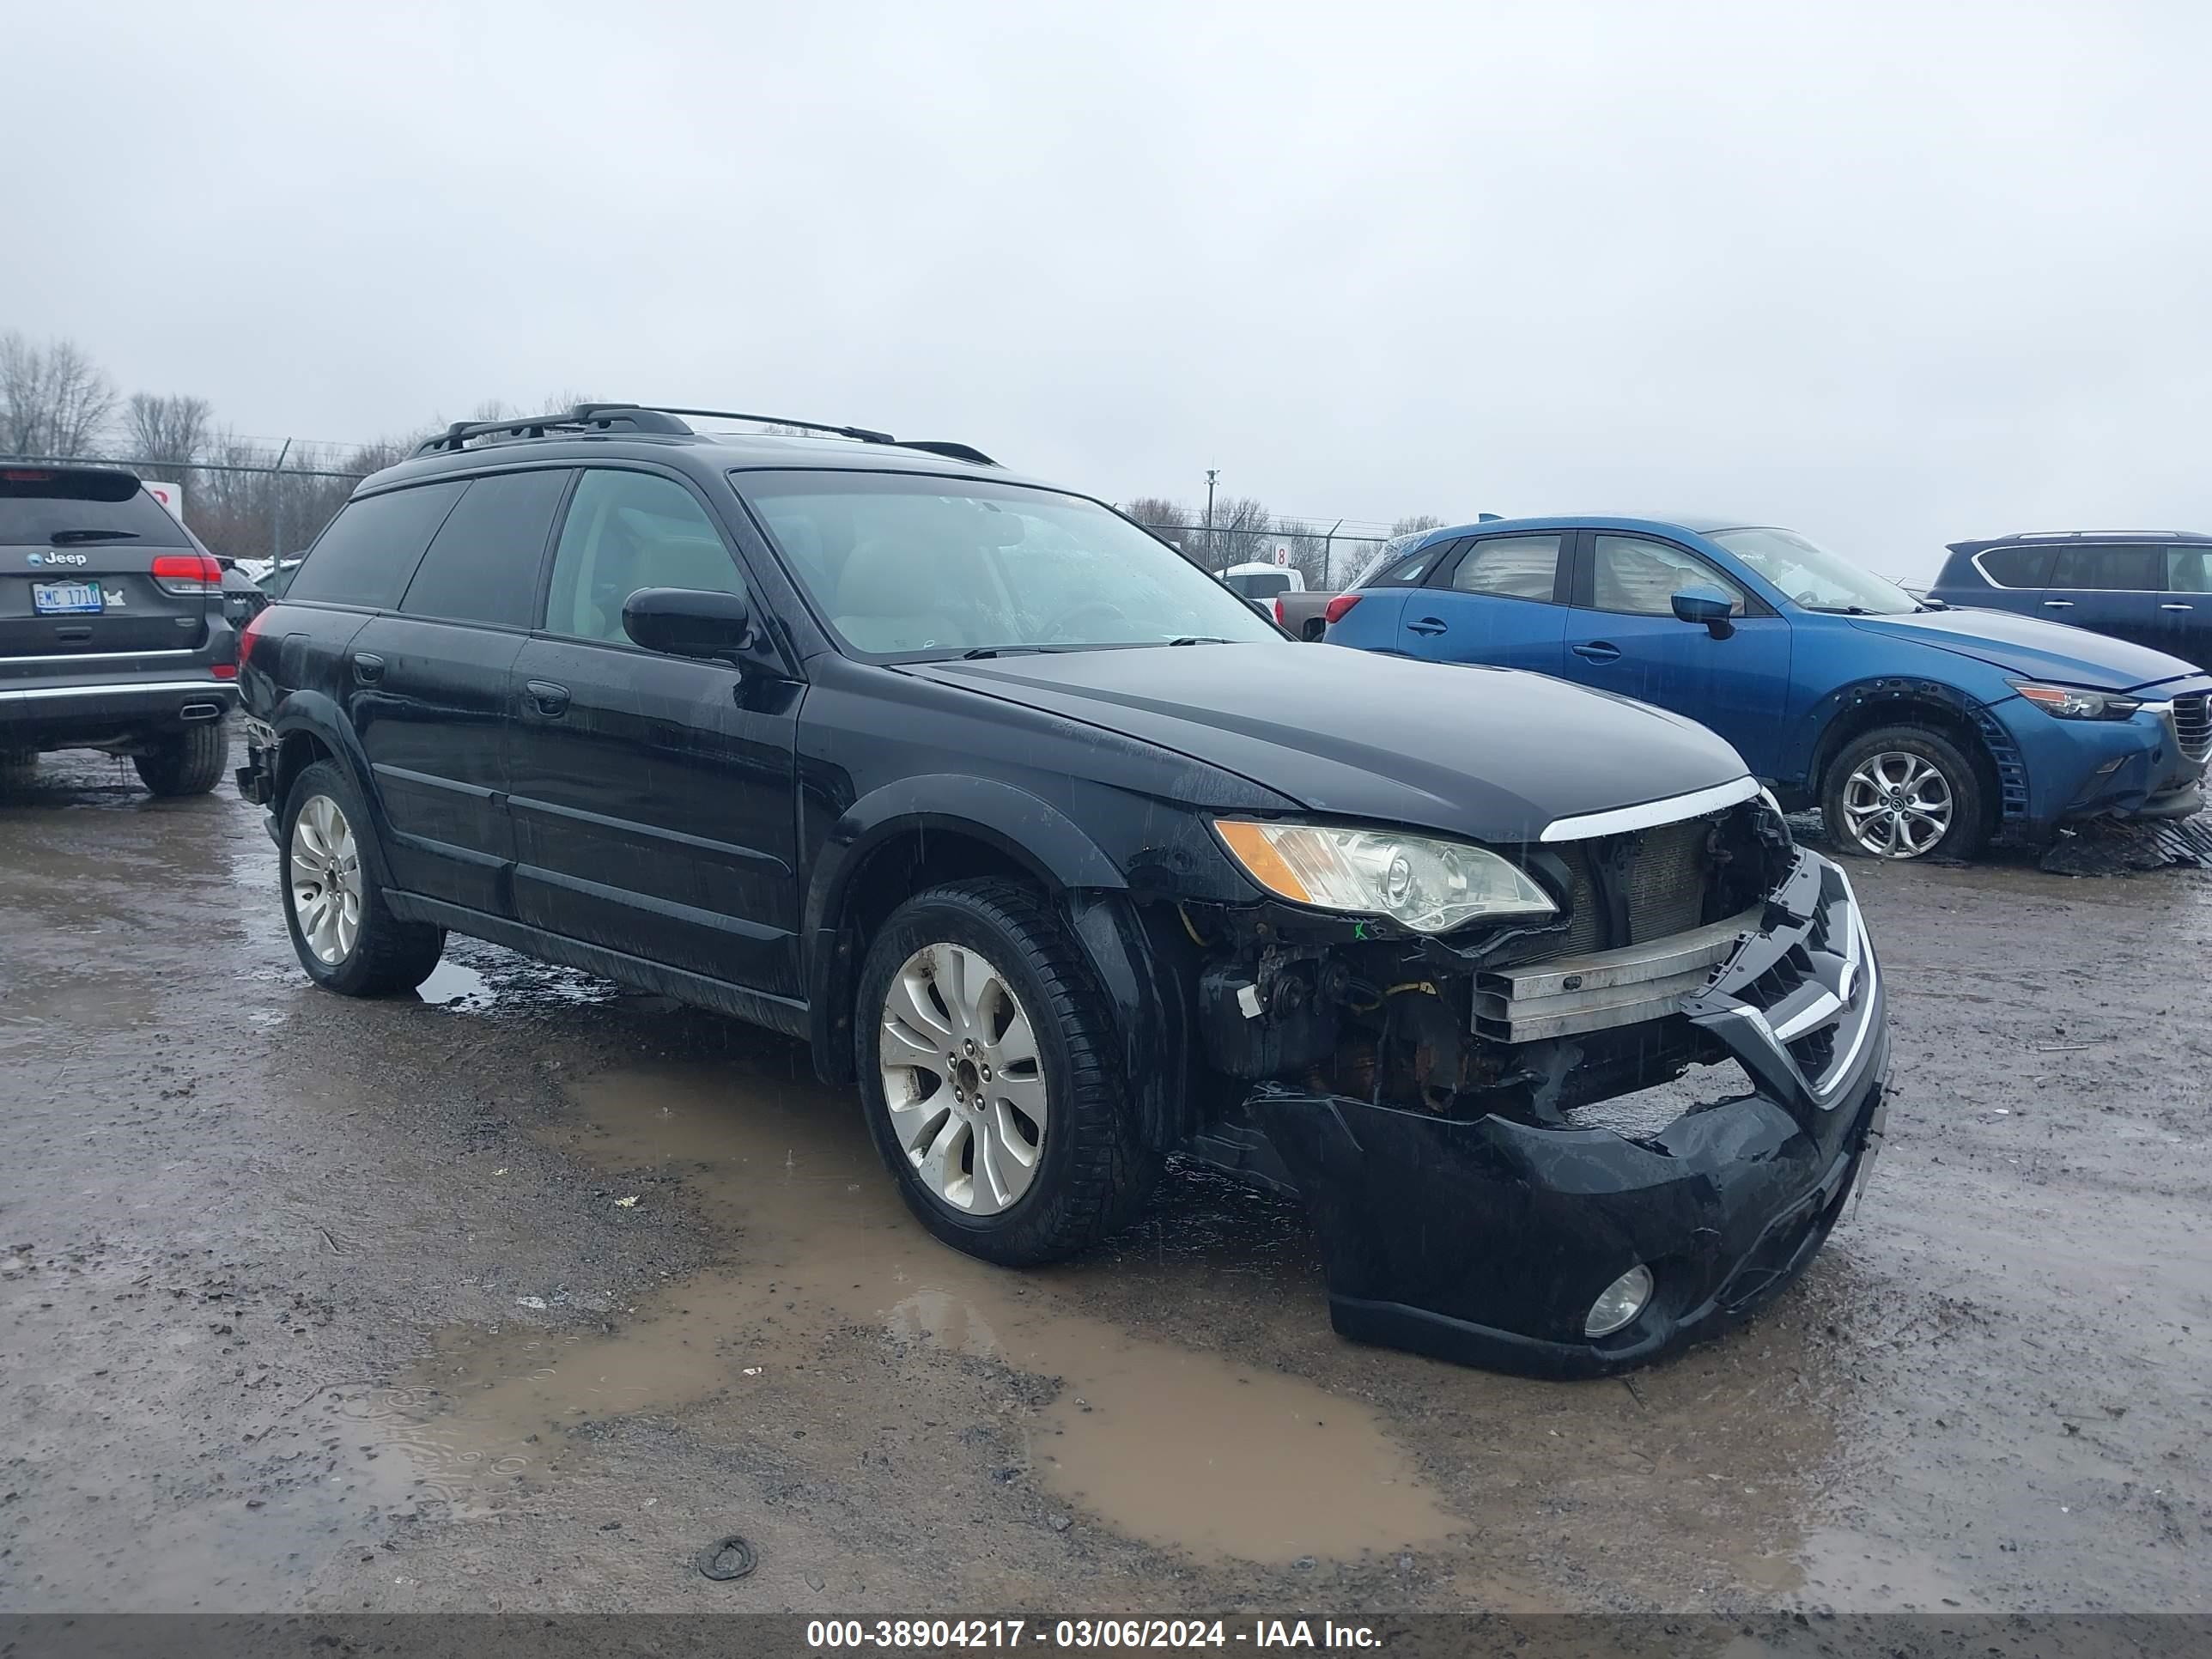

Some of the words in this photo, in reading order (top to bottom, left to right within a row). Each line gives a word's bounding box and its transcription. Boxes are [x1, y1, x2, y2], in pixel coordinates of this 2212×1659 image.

[45, 551, 88, 567] Jeep
[1279, 548, 1285, 565] 8
[36, 590, 60, 606] EMC
